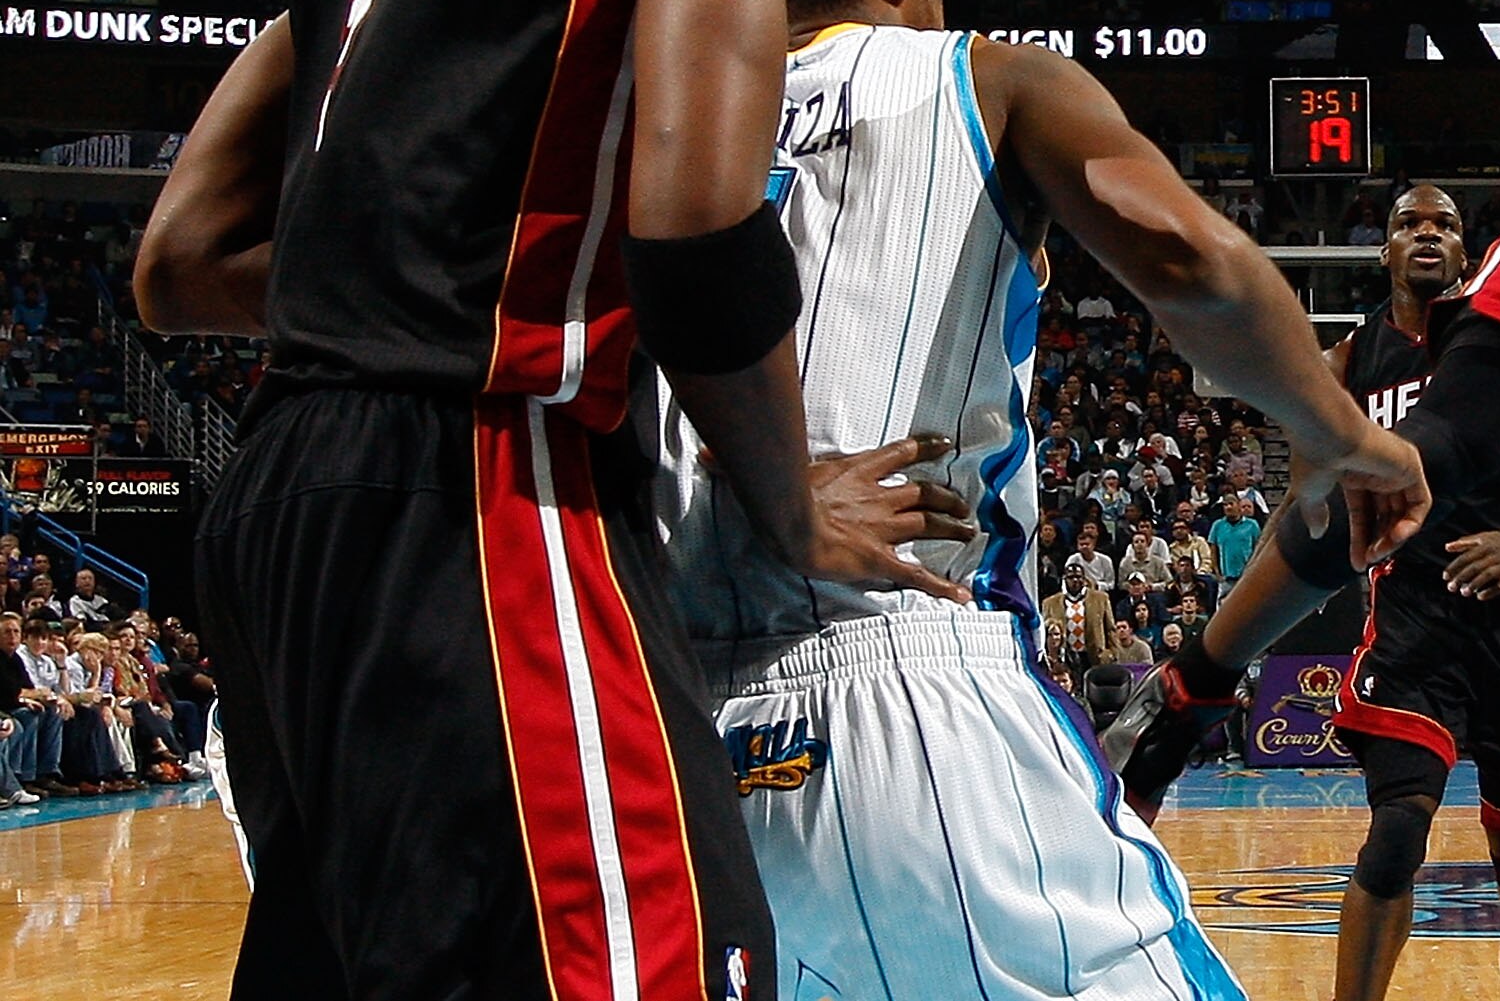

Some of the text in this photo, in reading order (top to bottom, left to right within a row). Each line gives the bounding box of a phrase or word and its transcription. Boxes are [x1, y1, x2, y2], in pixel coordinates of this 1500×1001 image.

[46, 10, 151, 42] DUNK
[160, 14, 274, 46] SPECI
[1094, 26, 1207, 59] $11.00
[1301, 90, 1357, 115] 3:51
[1310, 117, 1351, 163] 19
[25, 444, 60, 455] EXIT
[108, 481, 180, 496] CALORIES
[1255, 717, 1320, 756] Crown
